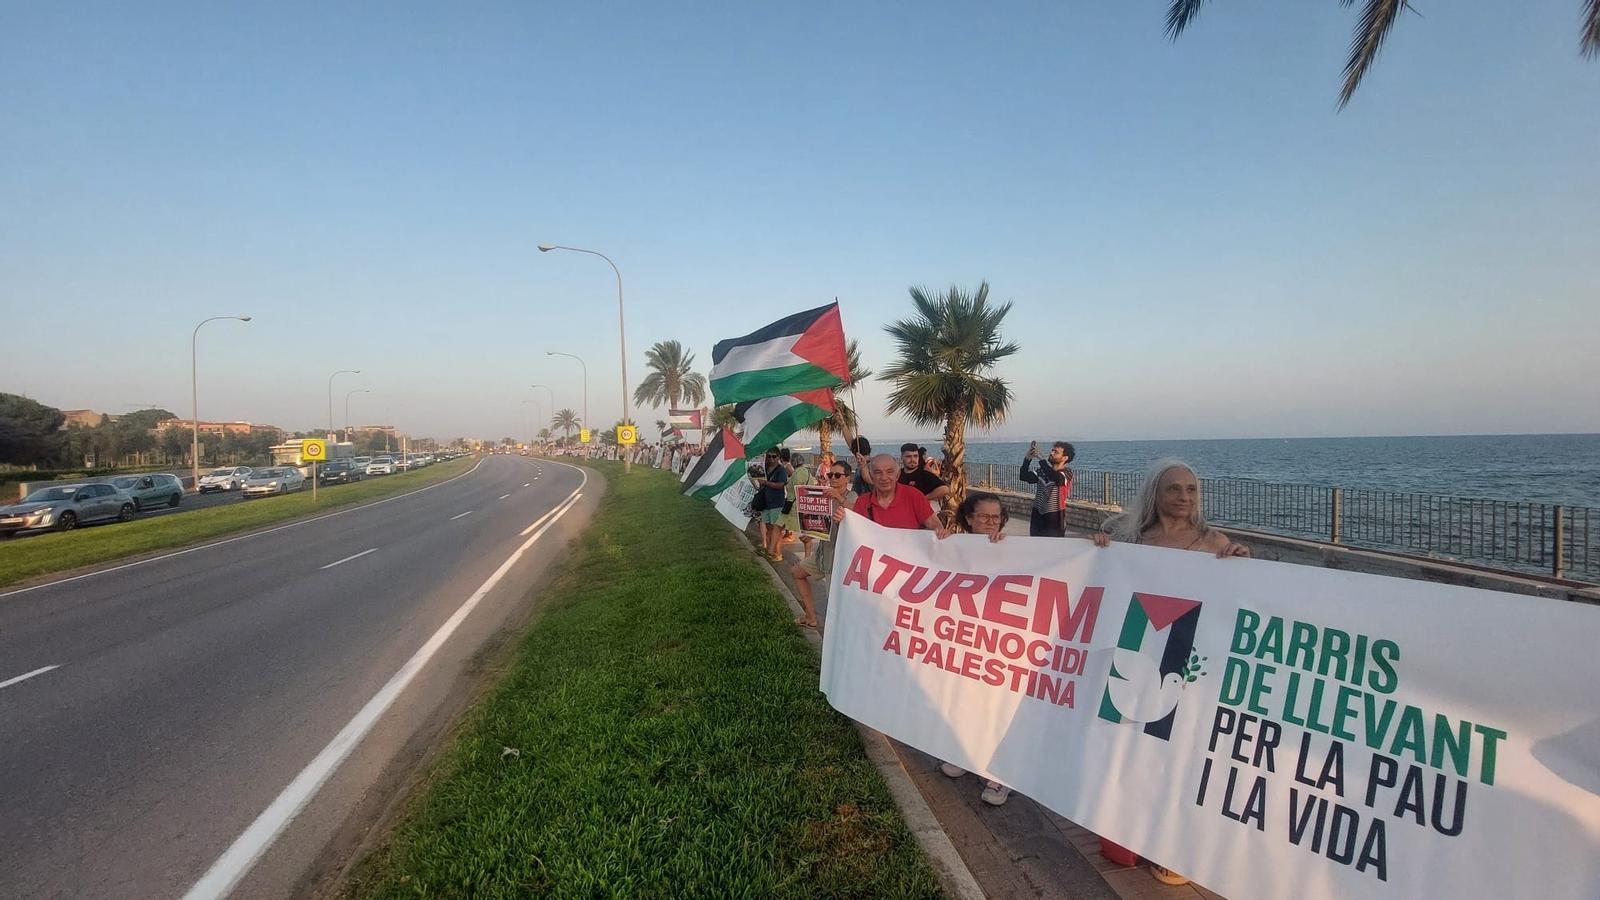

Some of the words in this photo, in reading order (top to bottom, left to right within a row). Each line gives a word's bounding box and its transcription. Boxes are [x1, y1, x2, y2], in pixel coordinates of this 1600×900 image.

[799, 504, 828, 512] GENOCIDE
[842, 545, 1104, 644] ATUREM
[883, 630, 901, 655] A
[906, 636, 1076, 710] PALESTINA
[895, 605, 925, 633] EL
[933, 615, 1088, 677] GENOCIDI
[1230, 608, 1400, 694] BARRIS
[1219, 656, 1276, 716] DE
[1282, 672, 1507, 786] LLEVANT
[1208, 706, 1282, 773] PER
[1295, 732, 1345, 797] LA
[1365, 752, 1468, 837] PAU
[1196, 758, 1213, 806] I
[1221, 766, 1267, 831] LA
[1288, 788, 1387, 882] VIDA
